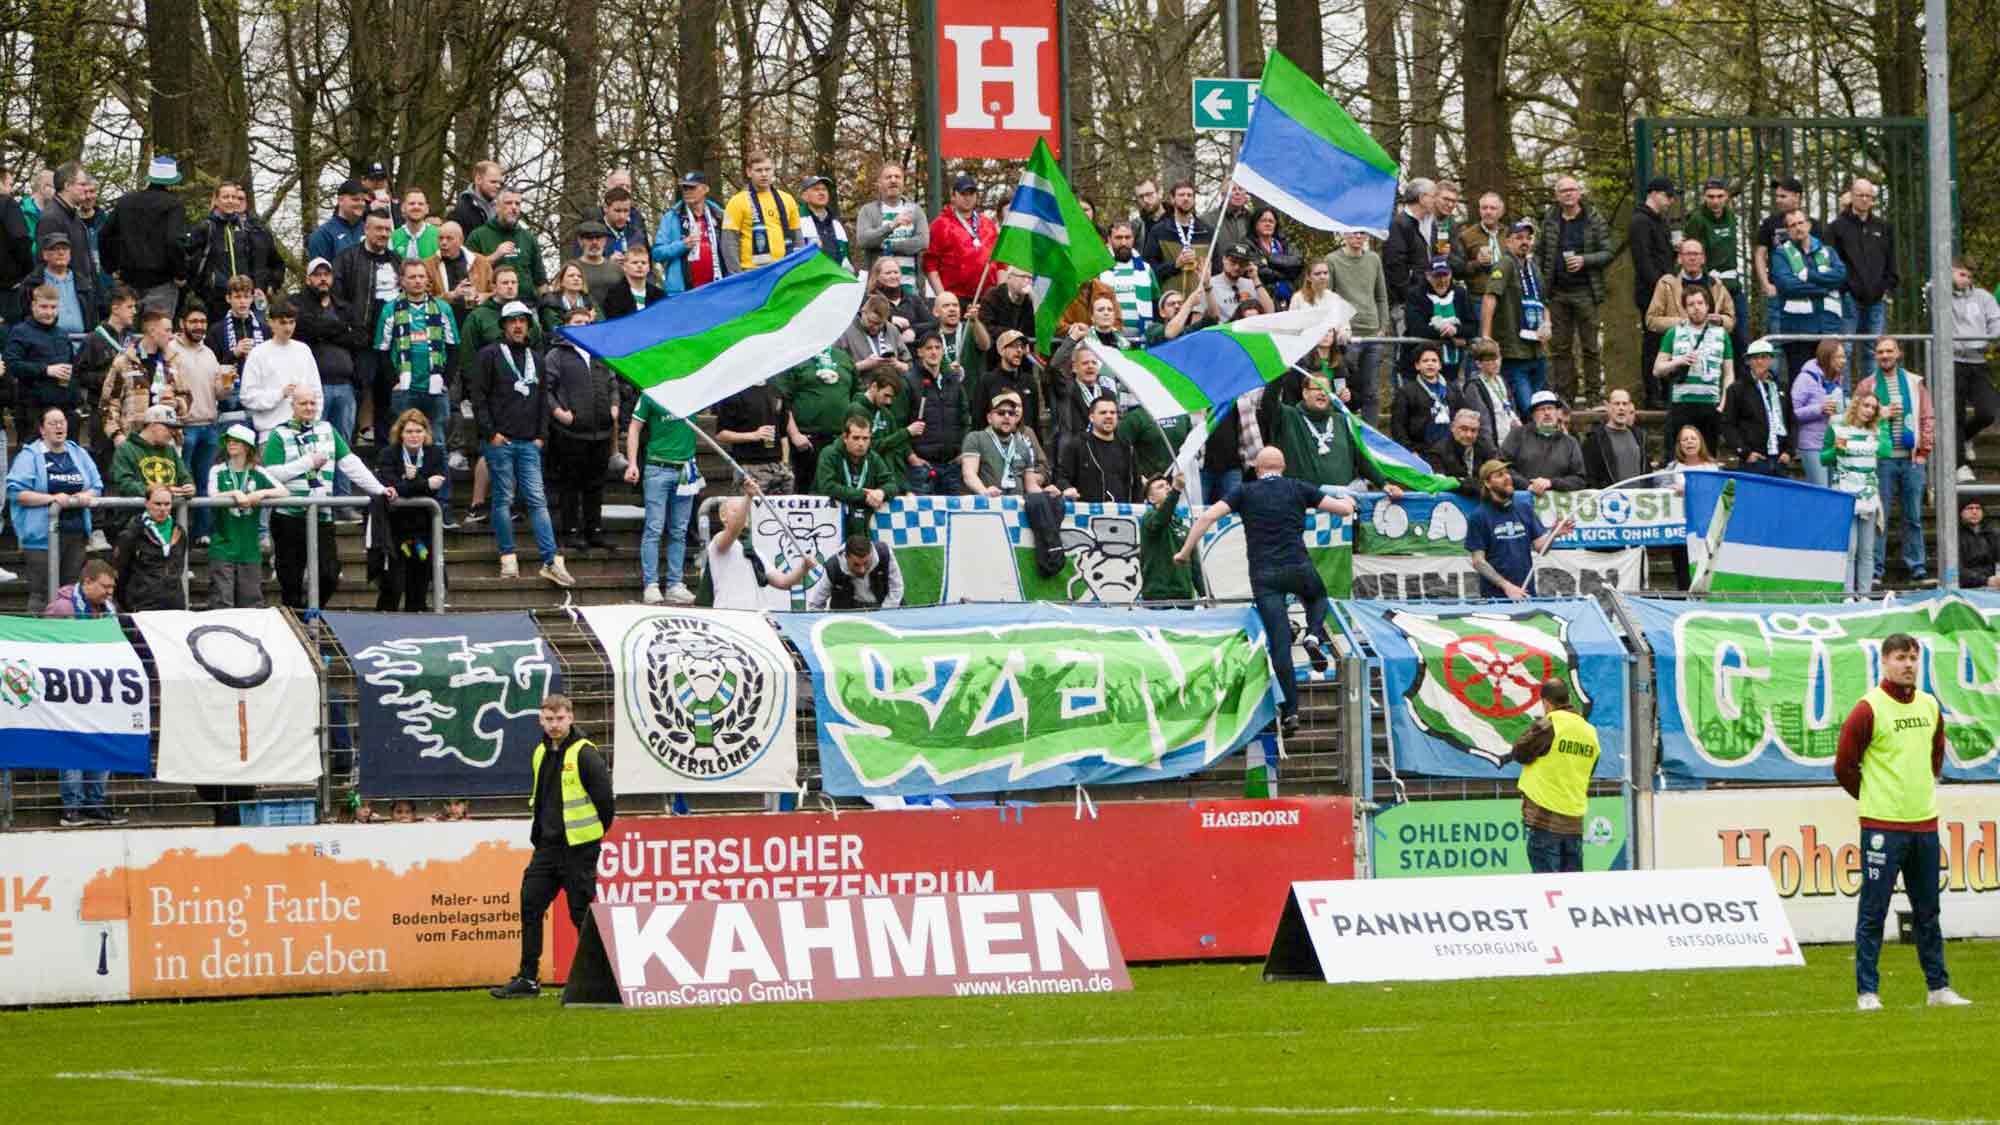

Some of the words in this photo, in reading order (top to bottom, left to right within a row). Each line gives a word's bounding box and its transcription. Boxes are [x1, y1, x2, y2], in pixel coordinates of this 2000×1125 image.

[943, 25, 1052, 131] H
[38, 667, 144, 705] BOYS
[648, 731, 761, 774] GÜTERSLOHER
[1200, 810, 1300, 828] HAGEDORN
[596, 833, 865, 878] GÜTERSLOHER
[1399, 847, 1508, 869] STADION
[265, 880, 361, 924] Farbe
[431, 894, 478, 906] Maler-
[483, 892, 511, 904] und
[1332, 908, 1529, 937] PANNHORST
[1568, 900, 1760, 928] PANNHORST
[415, 931, 446, 942] vom
[611, 891, 1110, 988] KAHMEN
[1435, 941, 1538, 957] ENTSORGUNG
[1668, 932, 1769, 948] ENTSORGUNG
[154, 941, 189, 981] in
[201, 936, 275, 979] dein
[281, 933, 390, 977] Leben
[624, 982, 742, 1008] TransCargo
[748, 980, 813, 1002] GmbH
[953, 974, 1113, 996] www.kahmen.de
